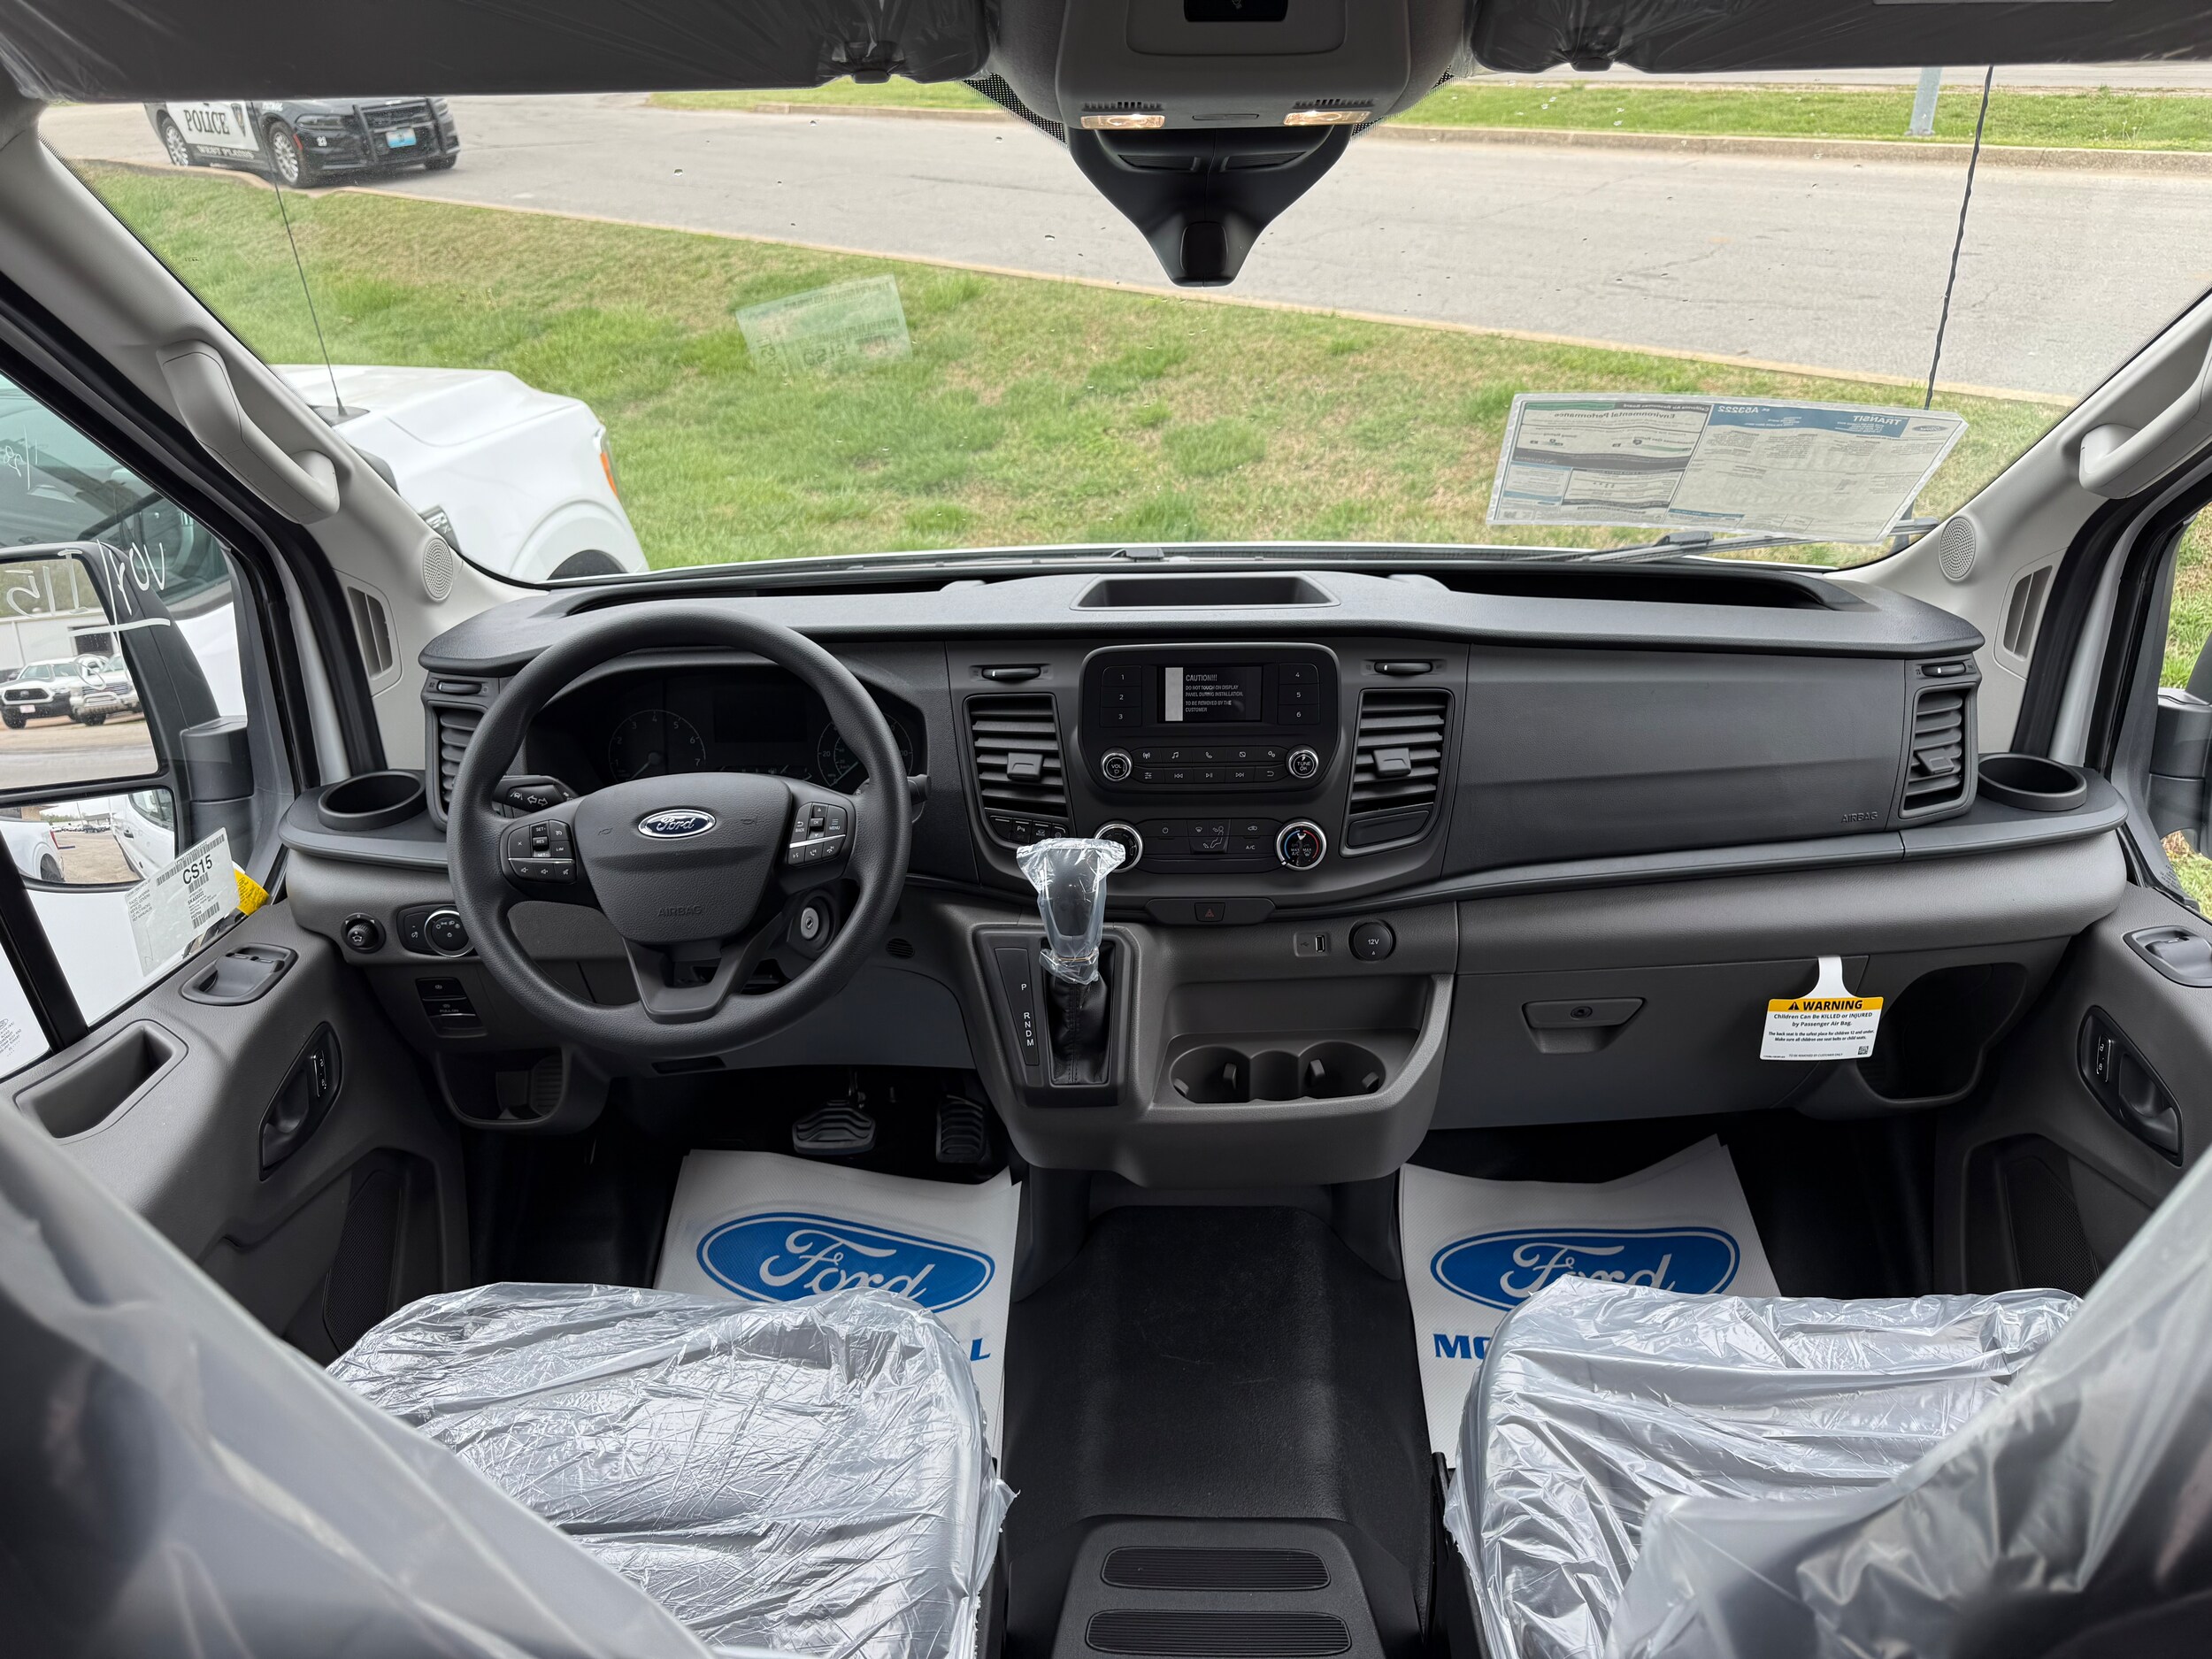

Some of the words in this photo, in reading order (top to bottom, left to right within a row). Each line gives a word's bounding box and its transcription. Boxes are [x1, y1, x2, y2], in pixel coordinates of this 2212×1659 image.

[183, 110, 230, 134] POLICE
[196, 145, 221, 156] WEST
[221, 148, 254, 159] PLAINS
[656, 815, 696, 832] Ford
[1841, 811, 1878, 823] AIRBAG
[182, 854, 212, 885] CS15
[657, 904, 703, 918] AIRBAG
[1802, 1000, 1863, 1010] WARNING
[759, 1229, 936, 1298] Ford
[1499, 1242, 1676, 1298] Frd
